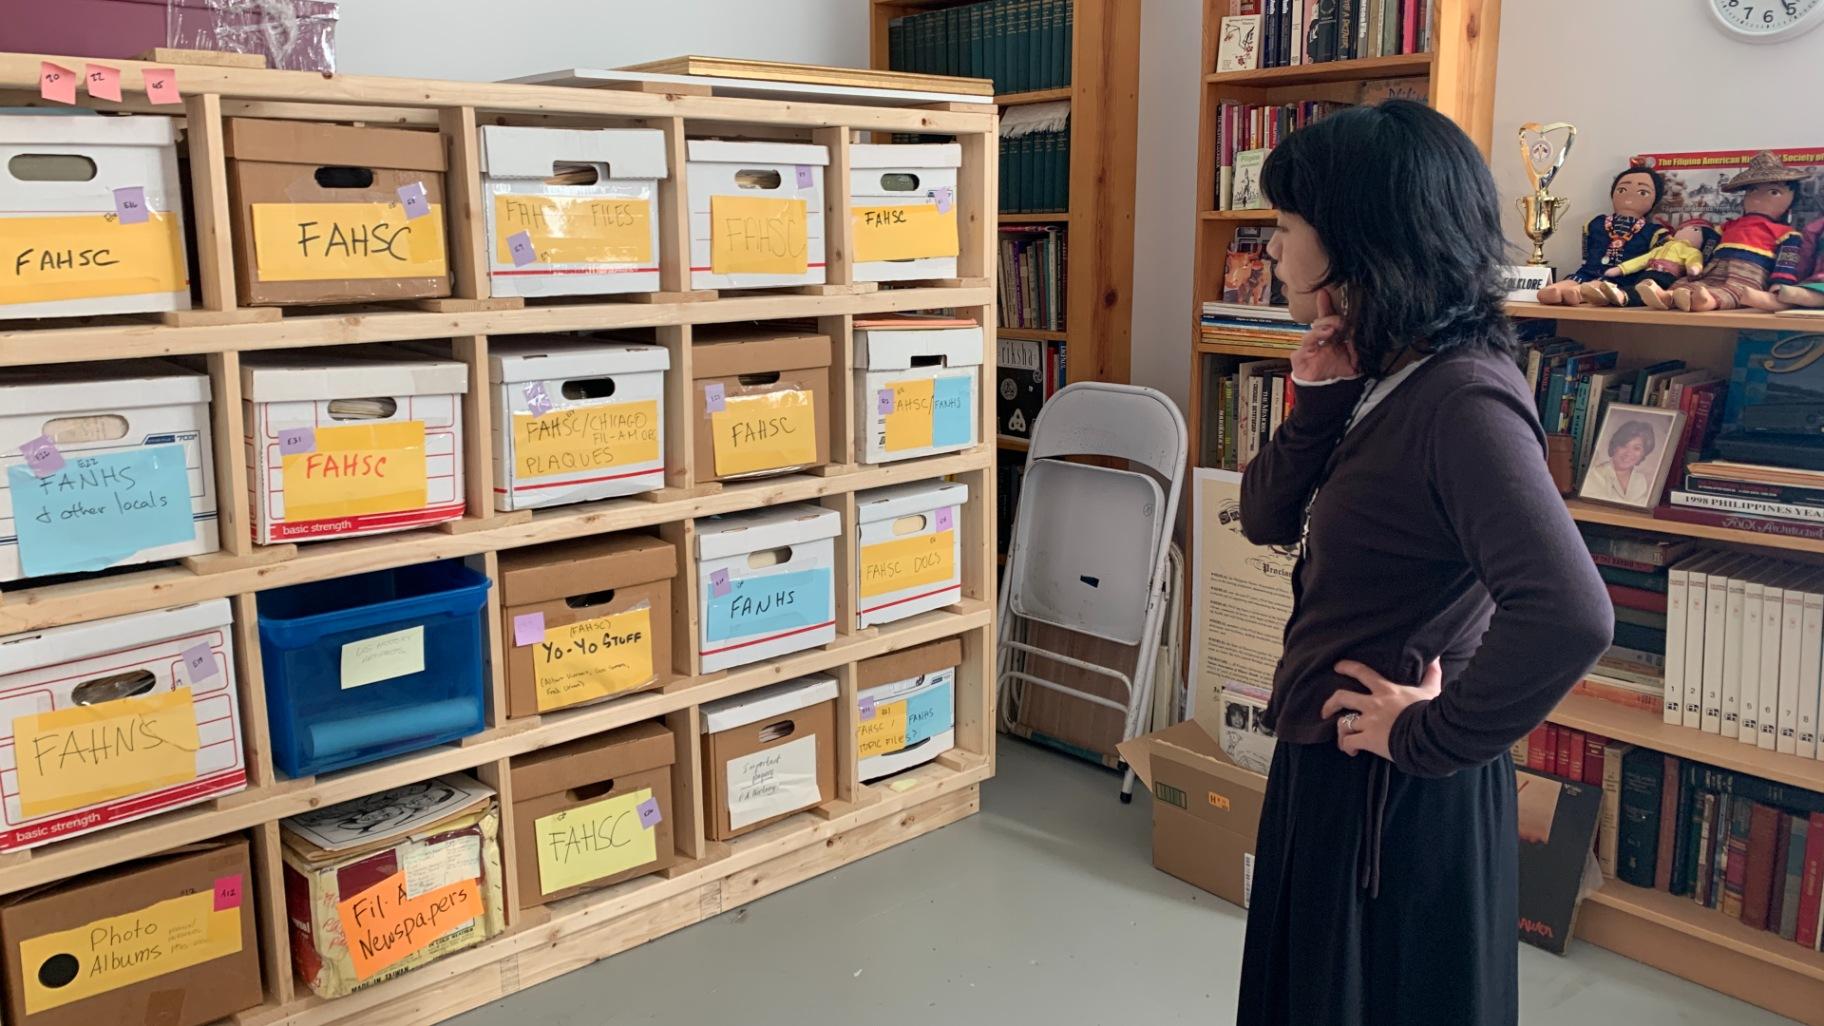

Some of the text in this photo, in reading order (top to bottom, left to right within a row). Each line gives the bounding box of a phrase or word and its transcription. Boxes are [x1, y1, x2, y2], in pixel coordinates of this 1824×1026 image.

[1743, 6, 1754, 20] 7
[1762, 9, 1774, 23] 6
[1785, 2, 1797, 15] 5
[1658, 158, 1672, 167] The
[1674, 157, 1701, 167] Filipino
[1702, 156, 1740, 165] American
[1782, 153, 1813, 163] Society
[591, 203, 635, 227] FILES
[864, 210, 907, 228] FAHSC
[297, 221, 412, 261] FAHSC
[725, 217, 807, 258] FAHSC
[16, 248, 121, 276] FAHSC
[1001, 342, 1033, 367] riksha
[1541, 367, 1551, 391] MANILA
[893, 395, 934, 415] AHSC/
[731, 416, 797, 448] FAHSC
[306, 453, 387, 480] FAHSC
[526, 447, 614, 474] PLAQUES
[39, 466, 136, 496] FANHS
[60, 503, 107, 520] other
[114, 491, 168, 515] locals
[1684, 496, 1824, 518] 1998 PHILIPPINES YEA
[282, 520, 352, 536] basic strength
[731, 591, 795, 619] FANHS
[1710, 691, 1715, 699] 3
[908, 708, 934, 726] FANHS
[33, 718, 164, 777] FAHNS
[16, 811, 101, 843] basic strength
[549, 810, 632, 864] FAHSC
[90, 919, 158, 951] Photo
[359, 888, 469, 961] Newspapers
[89, 944, 163, 978] Albums
